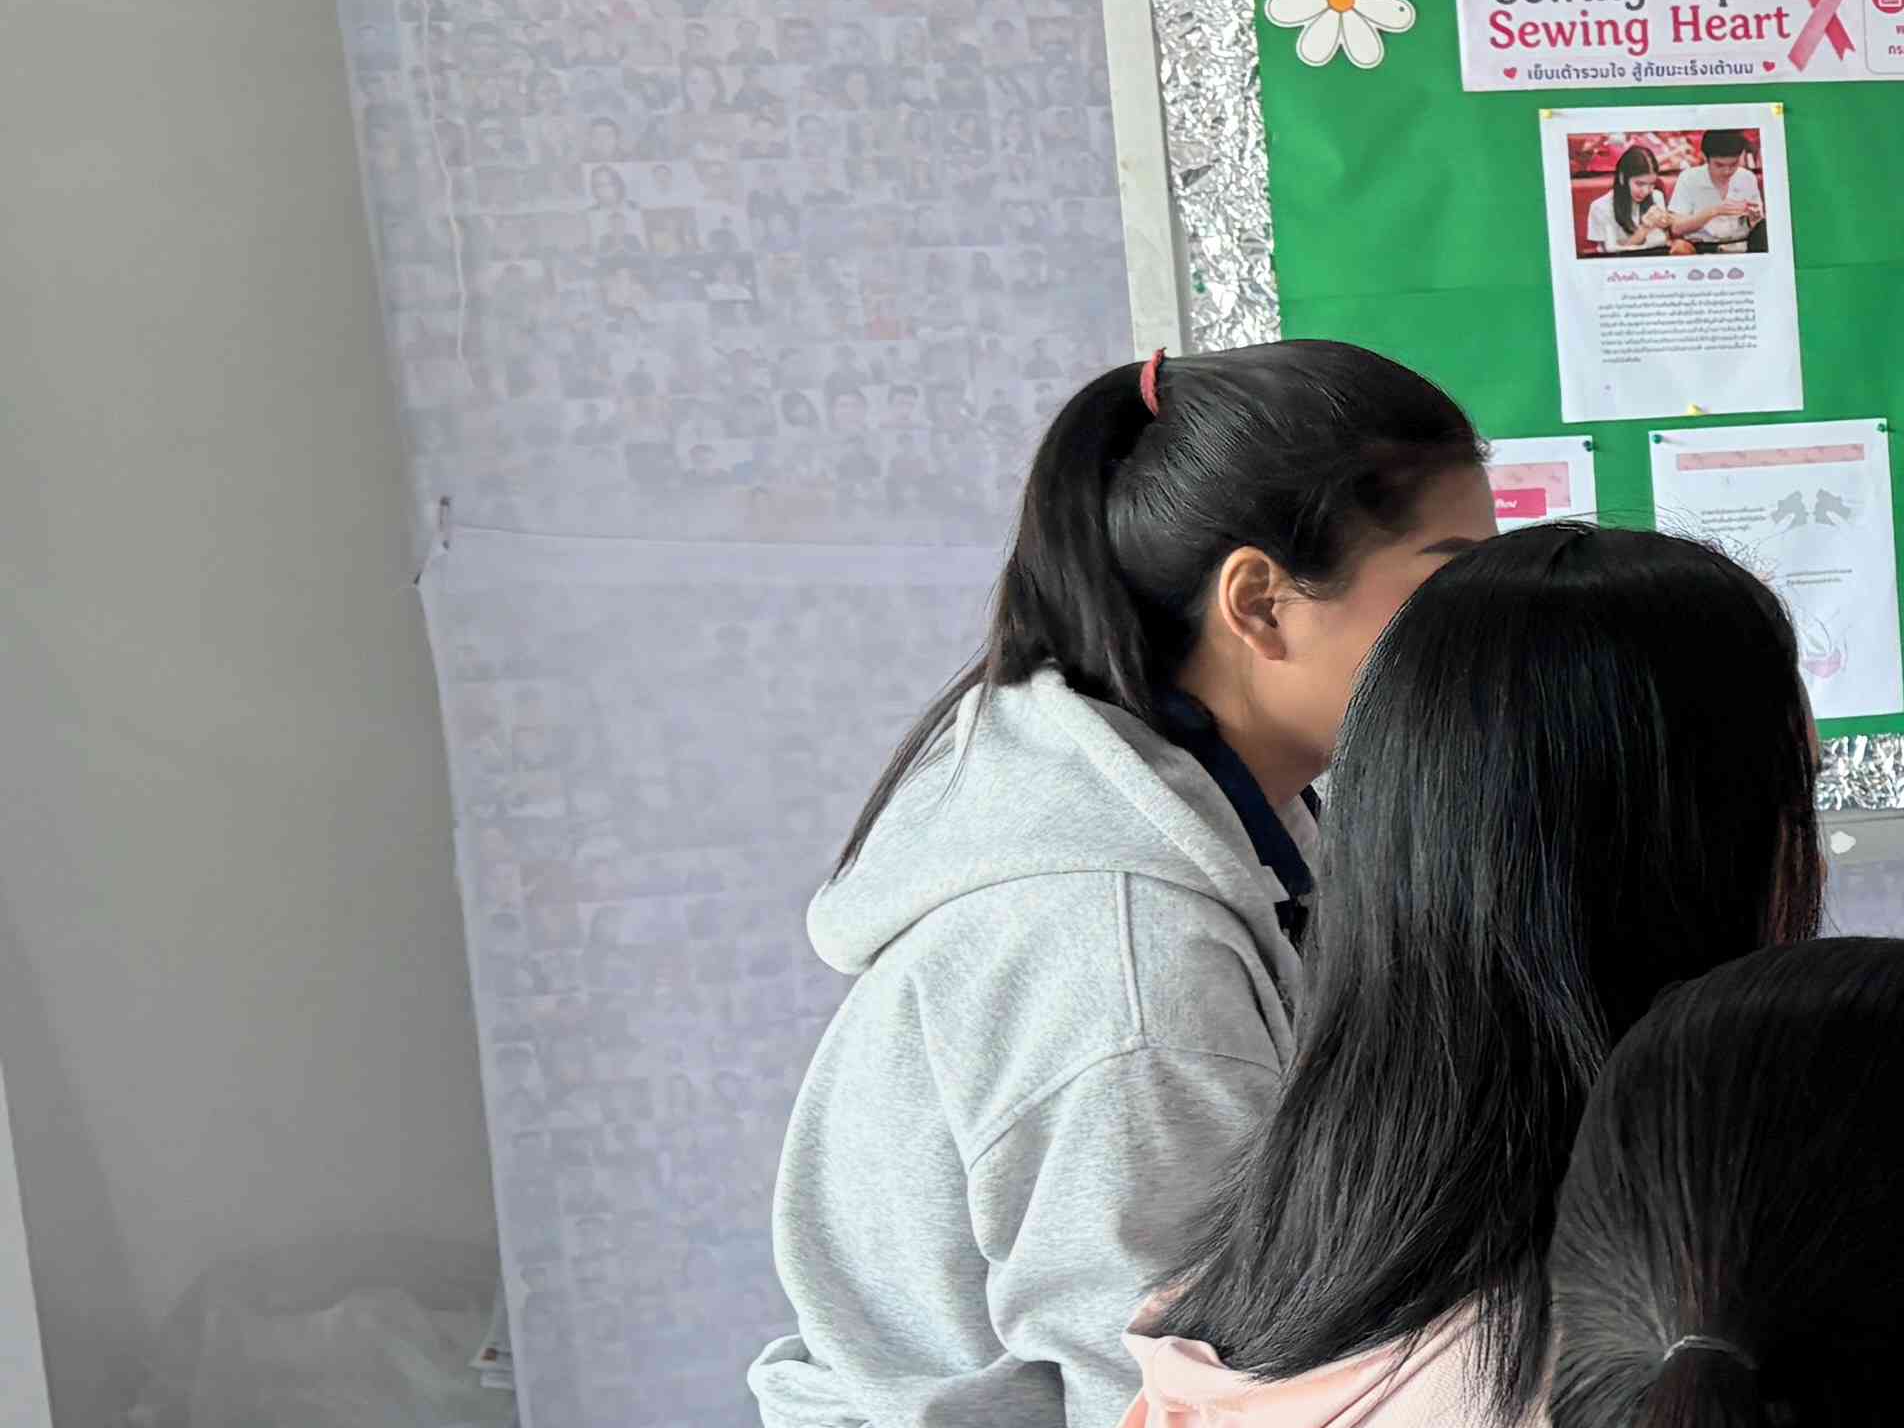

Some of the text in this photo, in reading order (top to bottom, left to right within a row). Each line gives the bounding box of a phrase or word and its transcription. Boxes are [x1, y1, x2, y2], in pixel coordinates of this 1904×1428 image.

[1488, 5, 1792, 56] Sewing Heart
[1527, 60, 1755, 83] เย็บเต้ารวมใจ สู้ภัยมะเร็งเต้านม
